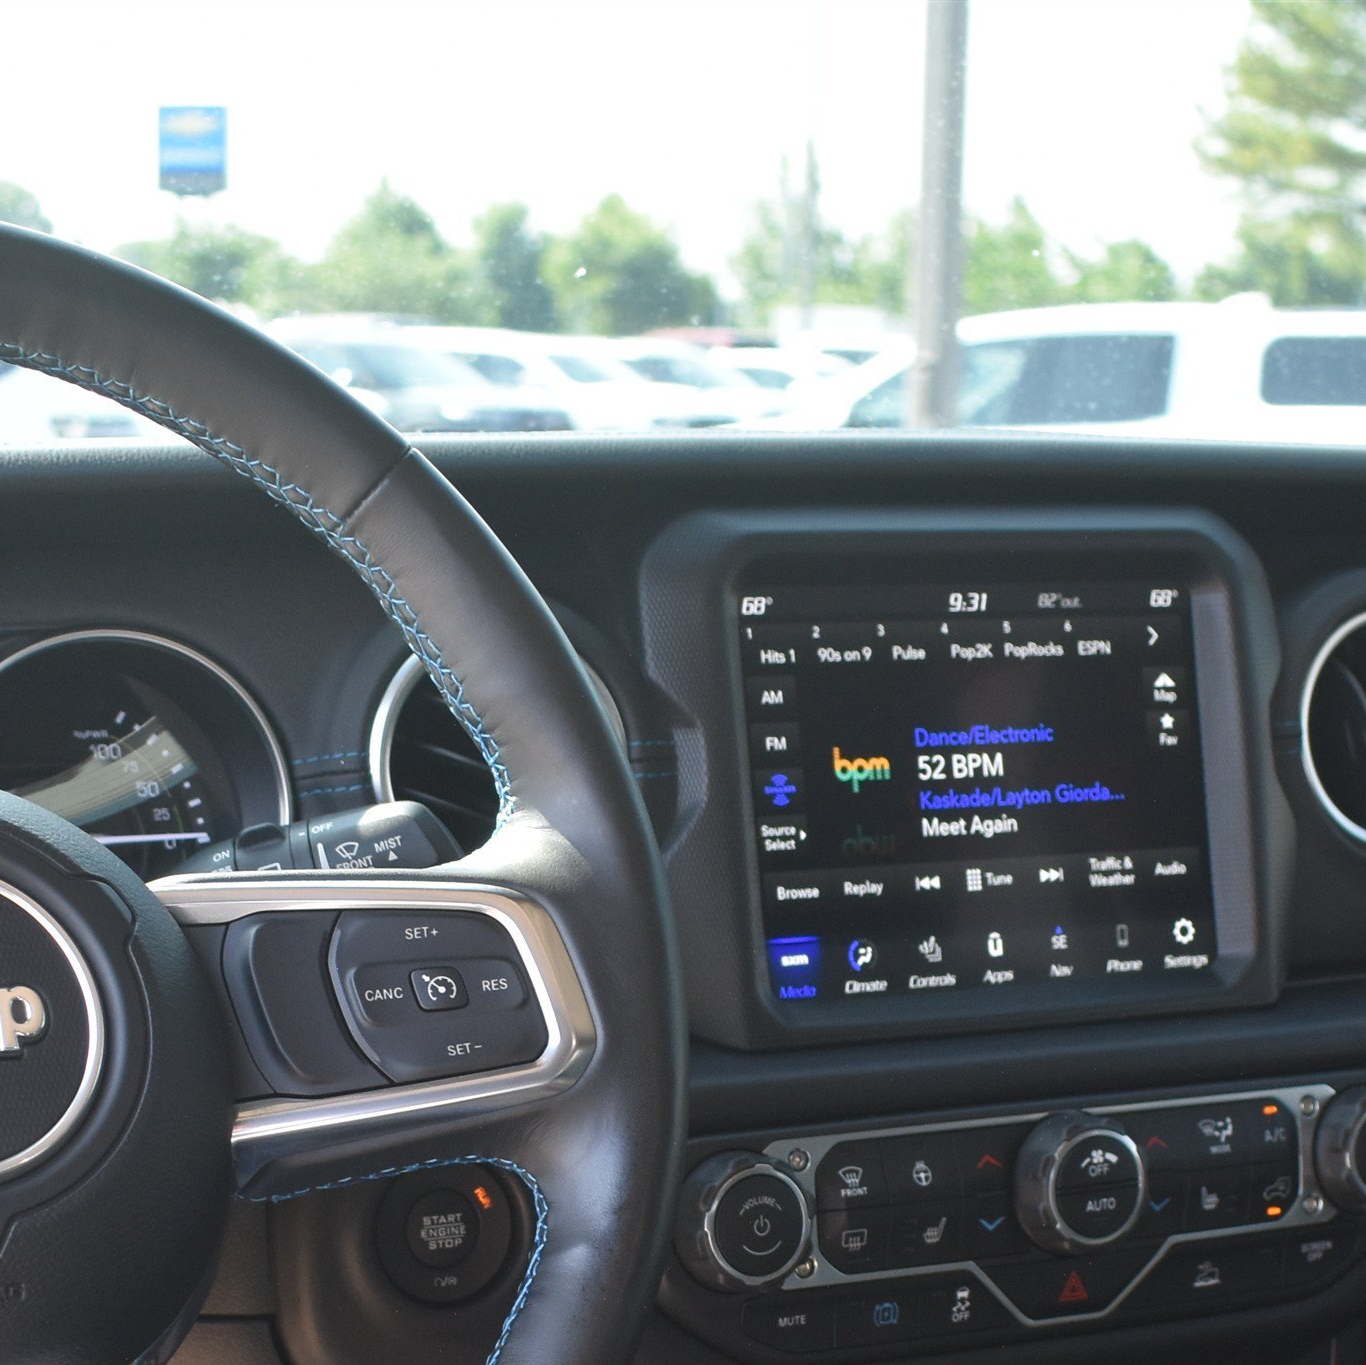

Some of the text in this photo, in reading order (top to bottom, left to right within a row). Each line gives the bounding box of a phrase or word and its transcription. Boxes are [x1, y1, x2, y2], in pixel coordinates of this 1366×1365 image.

[949, 591, 988, 612] 9:31
[746, 627, 753, 640] 1
[812, 625, 821, 639] 2
[876, 623, 885, 637] 3
[940, 621, 949, 635] 4
[1002, 620, 1012, 634] 5
[1063, 619, 1073, 633] 6
[817, 646, 872, 663] 90s on 9
[892, 644, 926, 660] Pulse
[950, 642, 994, 661] Pop2K
[1003, 641, 1065, 660] PopRocks
[1077, 639, 1112, 656] ESPN
[760, 649, 786, 664] Hits
[761, 690, 784, 705] AM
[1153, 688, 1178, 704] Map
[914, 723, 1055, 747] Dance/Electronic
[1158, 732, 1179, 747] Fav
[765, 736, 787, 751] FM
[89, 743, 122, 761] 100
[833, 747, 891, 793] bpm
[917, 752, 1005, 781] 52 BPM
[136, 781, 160, 797] 50
[918, 786, 1052, 810] Kaskade/Layton
[153, 807, 171, 821] 25
[312, 821, 334, 834] OFF
[760, 824, 796, 838] Source
[921, 813, 1019, 839] Meet Again
[373, 835, 403, 853] MIST
[764, 839, 796, 852] Select
[212, 849, 231, 863] ON
[1089, 855, 1134, 872] Traffic &
[1154, 861, 1187, 876] Audio
[985, 871, 1014, 886] Tune
[1088, 872, 1135, 888] Weather
[776, 886, 820, 901] Browse
[843, 880, 884, 897] Replay
[404, 926, 439, 940] SET+
[1051, 934, 1069, 950] SE
[1106, 958, 1143, 973] Phone
[1164, 953, 1209, 970] Settings
[983, 969, 1015, 985] Apps
[1049, 963, 1075, 978] Nav
[481, 977, 509, 992] RES
[844, 979, 888, 995] Climate
[908, 972, 957, 989] Controls
[364, 987, 404, 1002] CANC
[779, 985, 817, 999] Media
[1263, 1127, 1287, 1143] A/C
[1088, 1163, 1110, 1178] OFF
[840, 1186, 869, 1198] FRONT
[742, 1195, 778, 1211] VOLUME
[1085, 1196, 1116, 1213] AUTO
[422, 1213, 463, 1226] START
[420, 1225, 467, 1239] ENGINE
[428, 1238, 463, 1251] STOP
[777, 1314, 807, 1328] MUTE
[951, 1310, 971, 1323] OFF
